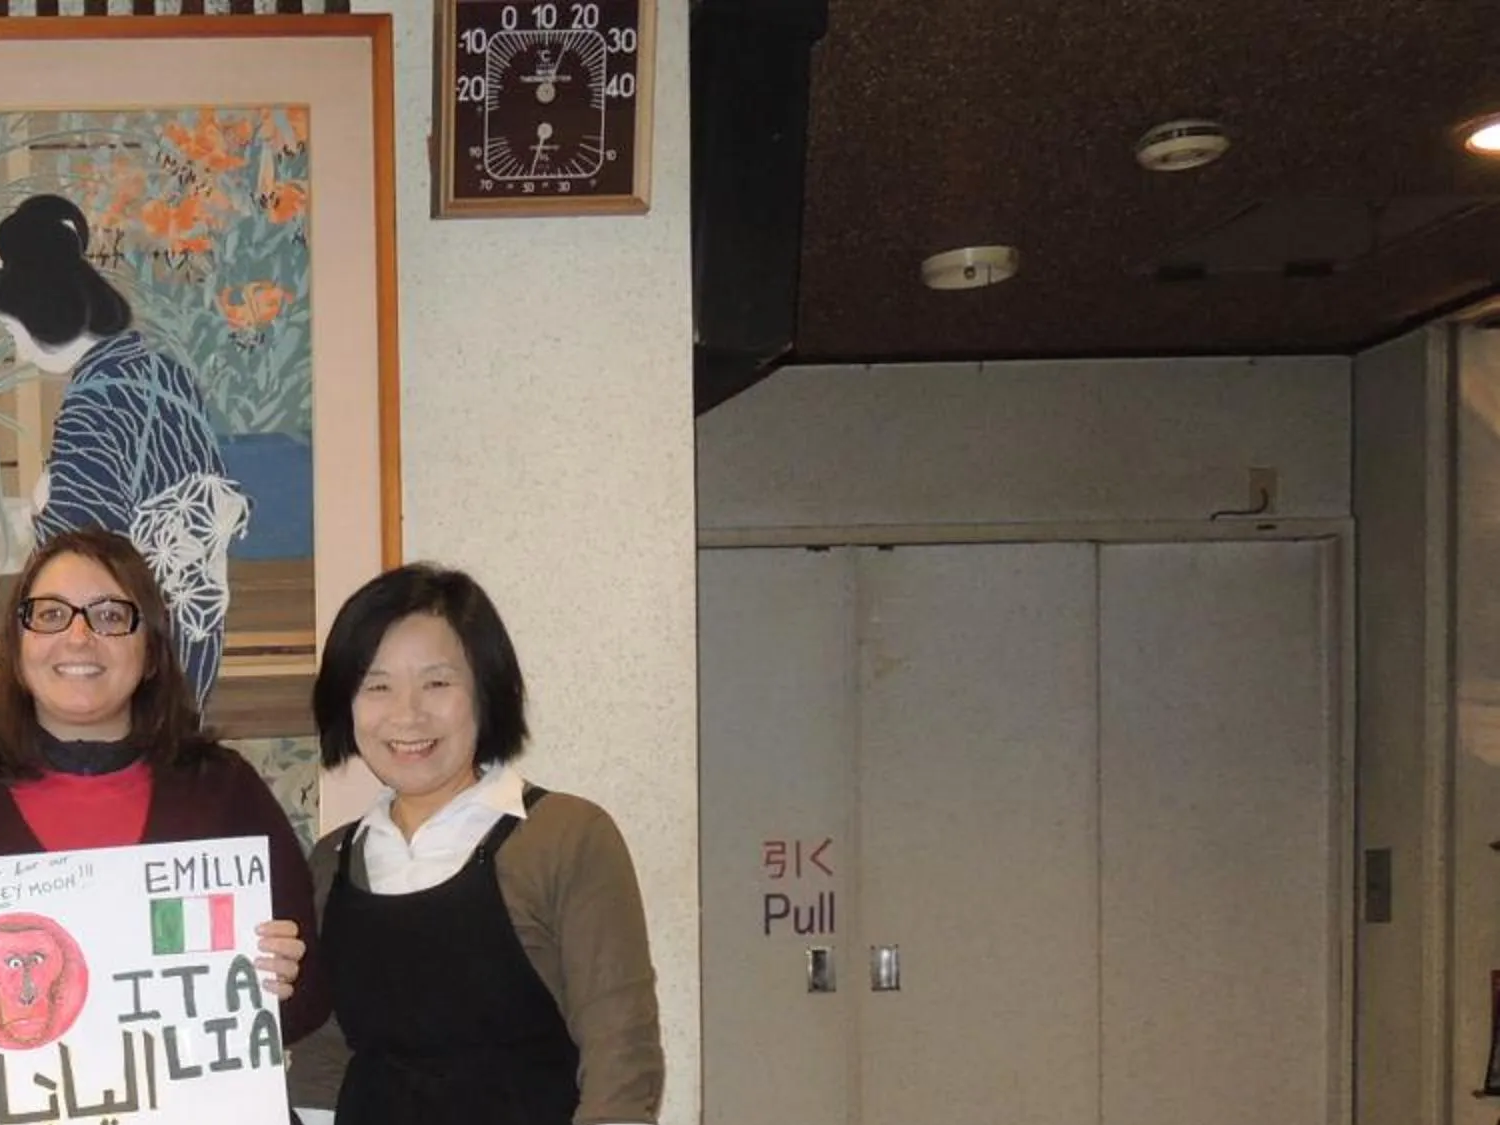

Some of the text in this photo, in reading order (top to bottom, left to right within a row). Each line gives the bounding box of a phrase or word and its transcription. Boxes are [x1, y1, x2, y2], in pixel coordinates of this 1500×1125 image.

[501, 6, 517, 31] 0
[531, 4, 557, 29] 10
[571, 3, 599, 29] 20
[607, 28, 636, 53] 30
[606, 73, 635, 98] 40
[145, 853, 266, 893] EMILIA
[762, 836, 834, 880] 引く
[763, 891, 836, 937] Pull
[112, 954, 263, 1024] ITA
[162, 1008, 284, 1081] LIA
